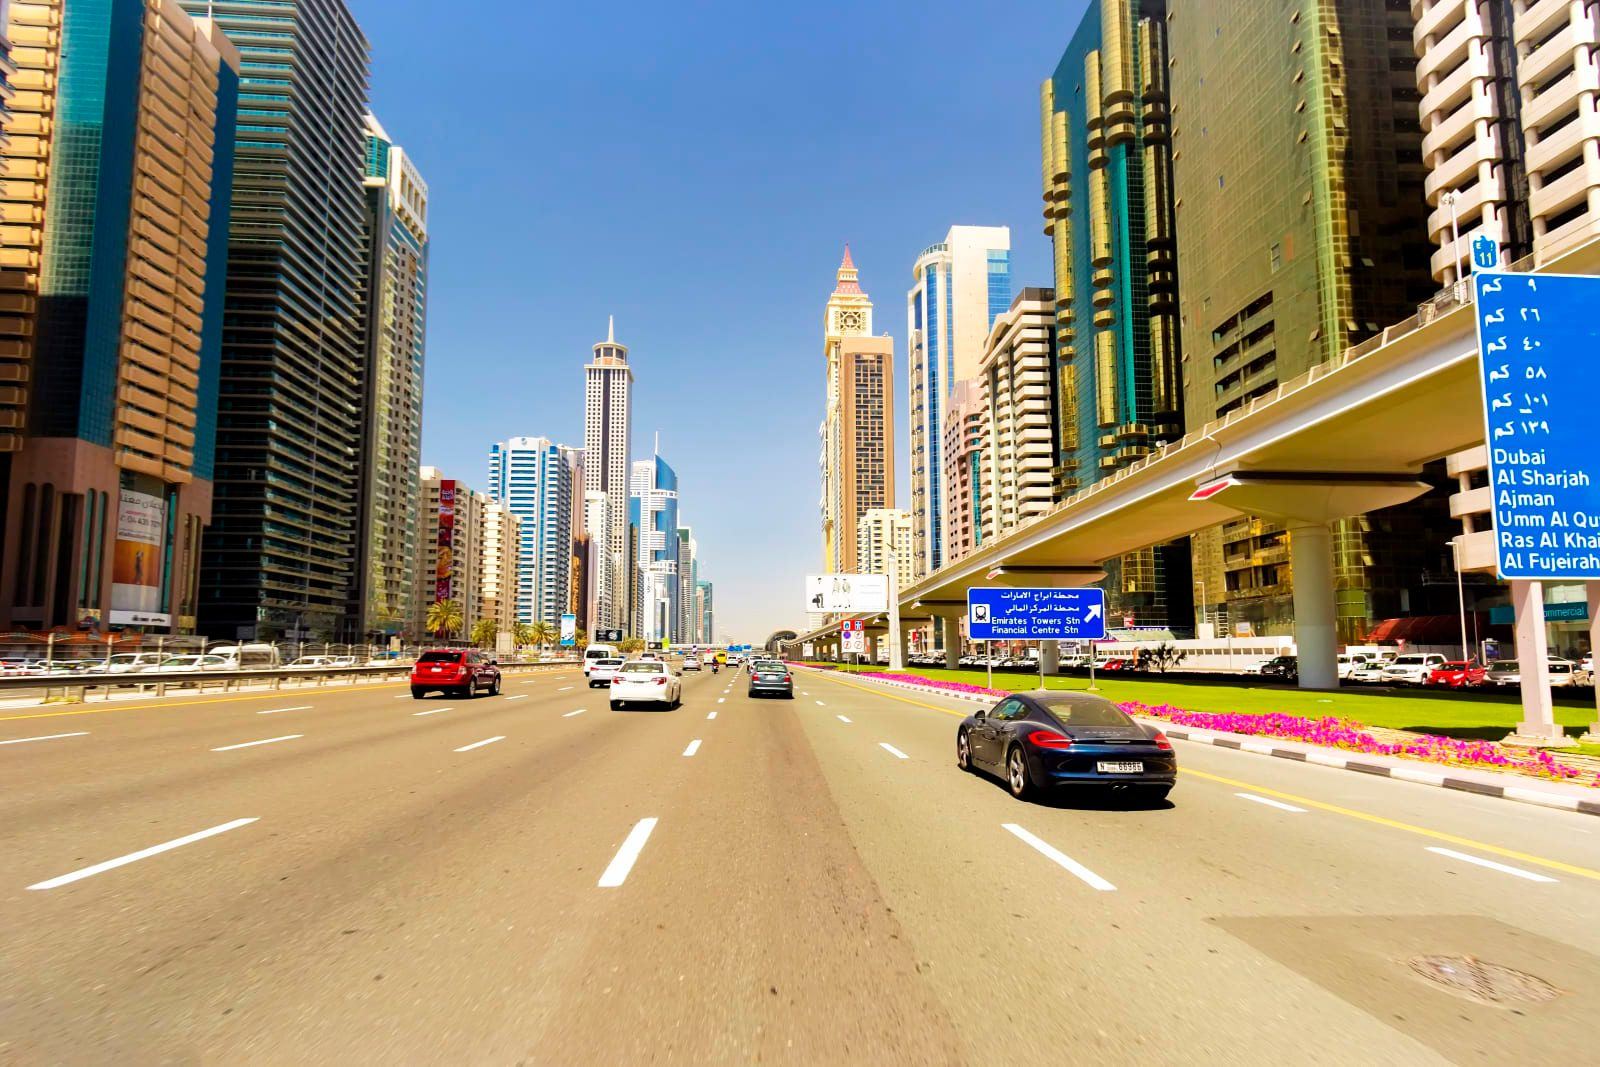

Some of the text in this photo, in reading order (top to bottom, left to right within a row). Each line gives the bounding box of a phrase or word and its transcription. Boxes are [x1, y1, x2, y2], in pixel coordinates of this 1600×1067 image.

[1479, 251, 1494, 266] 11
[1482, 277, 1537, 296] ٩ كم
[1484, 307, 1540, 327] ٢٦ كم
[1487, 336, 1541, 355] ٤٠ كم
[1489, 364, 1547, 384] ٥٨ كم
[1492, 392, 1513, 412] كم
[1494, 420, 1550, 441] ١٣٩ كم
[1494, 448, 1546, 465] Dubai
[1497, 469, 1590, 489] Al Sharjah
[1499, 489, 1555, 509] Ajman
[1499, 510, 1600, 529] Umm Al Qu
[1501, 531, 1535, 548] Ras
[1539, 531, 1559, 548] Al
[1504, 552, 1600, 572] Al Fujeirah
[1029, 603, 1053, 614] المركز
[1053, 603, 1080, 612] محطة
[1543, 606, 1585, 618] ommercial
[991, 617, 1081, 625] Emirates Towers Stn
[991, 626, 1079, 634] Financial Centre Stn
